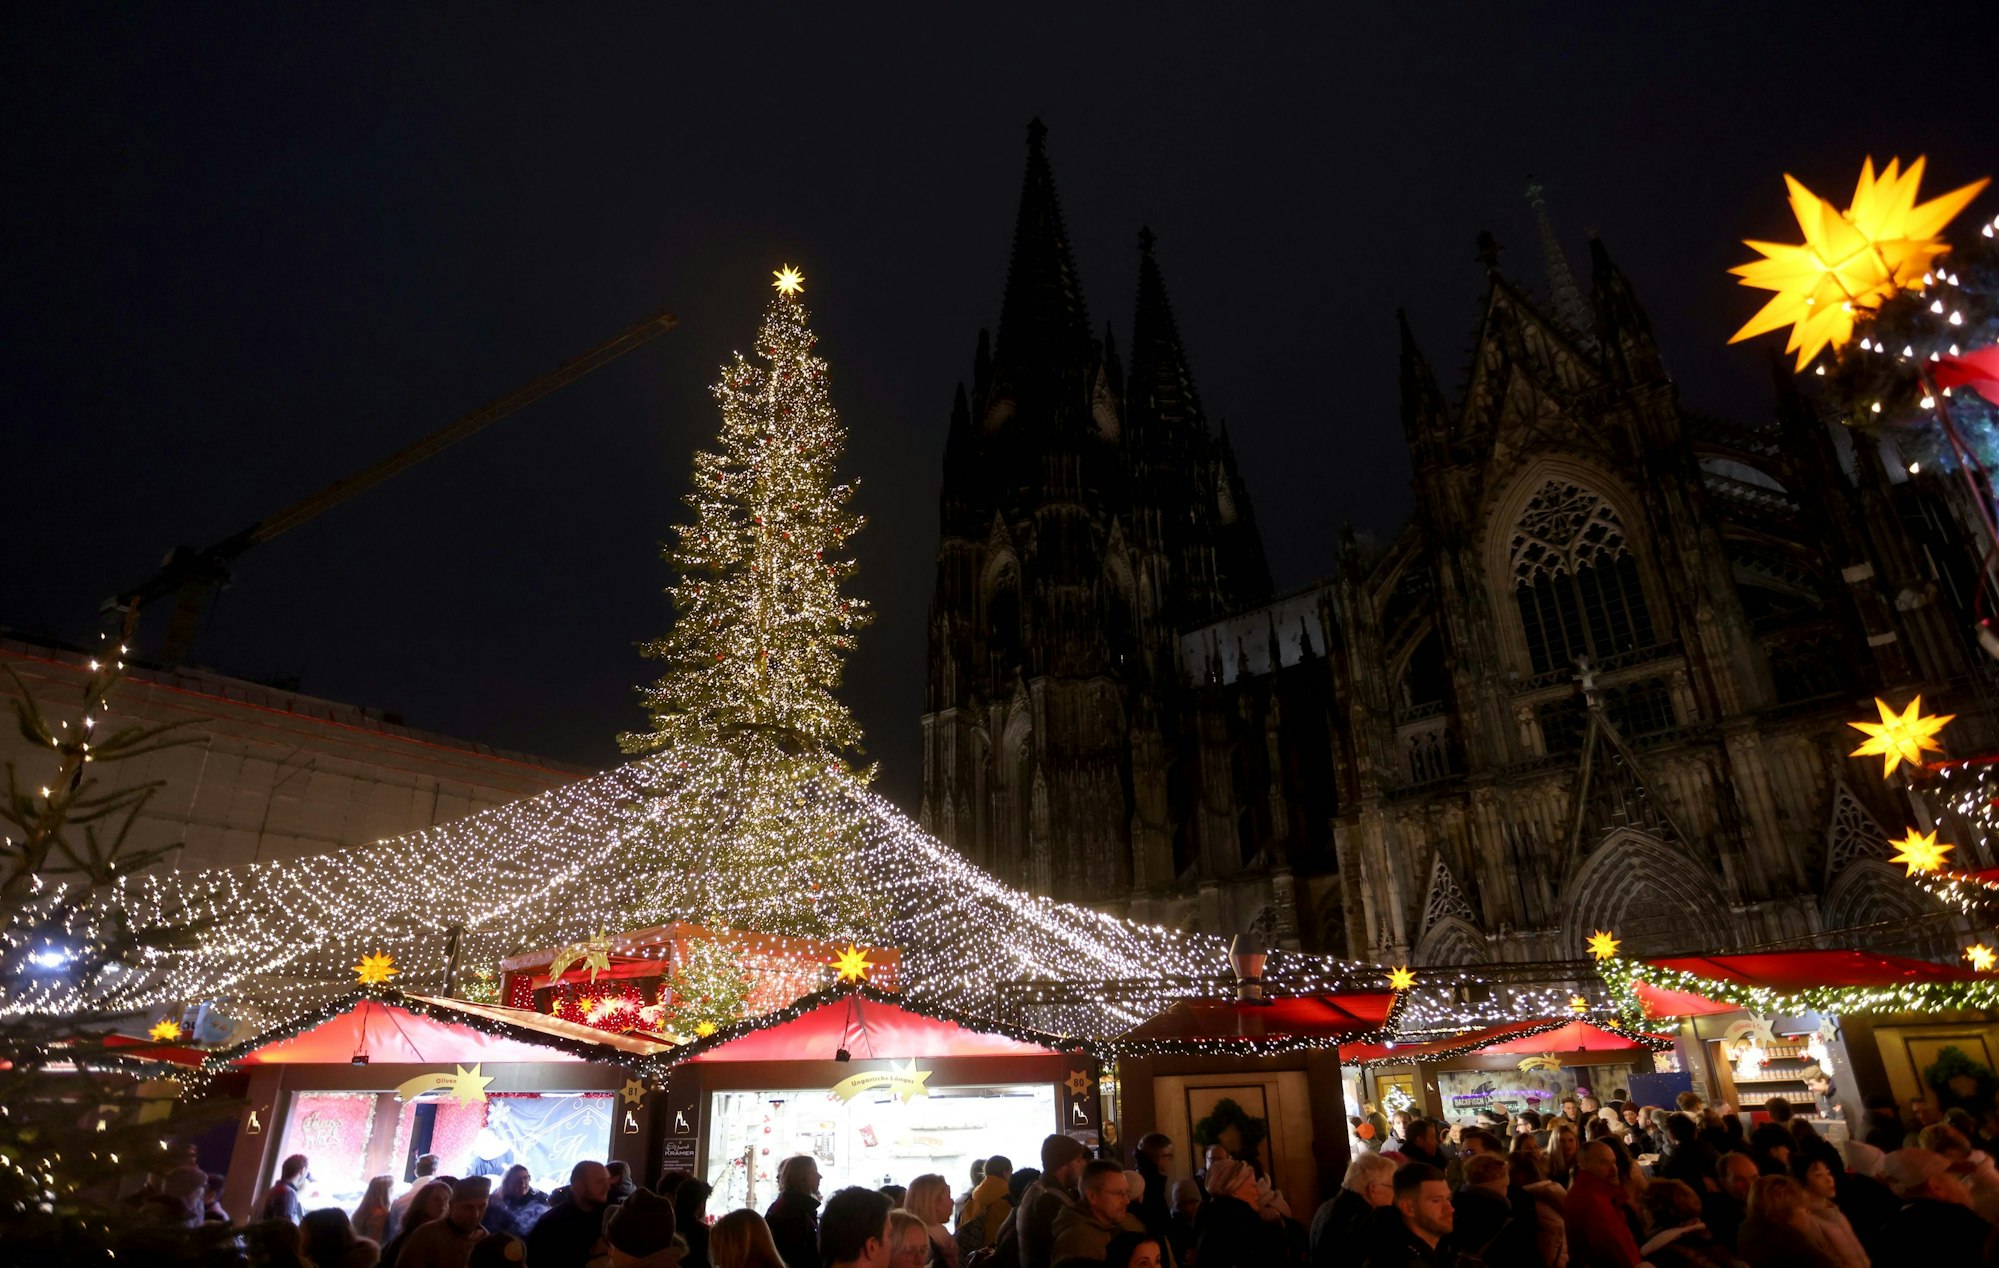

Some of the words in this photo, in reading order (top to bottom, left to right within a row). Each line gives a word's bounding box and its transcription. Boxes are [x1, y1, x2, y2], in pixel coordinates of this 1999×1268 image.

[850, 1075, 889, 1087] Ungarische
[1073, 1078, 1084, 1087] 80
[628, 1087, 638, 1096] 81
[1454, 1097, 1485, 1107] BACKFISCH
